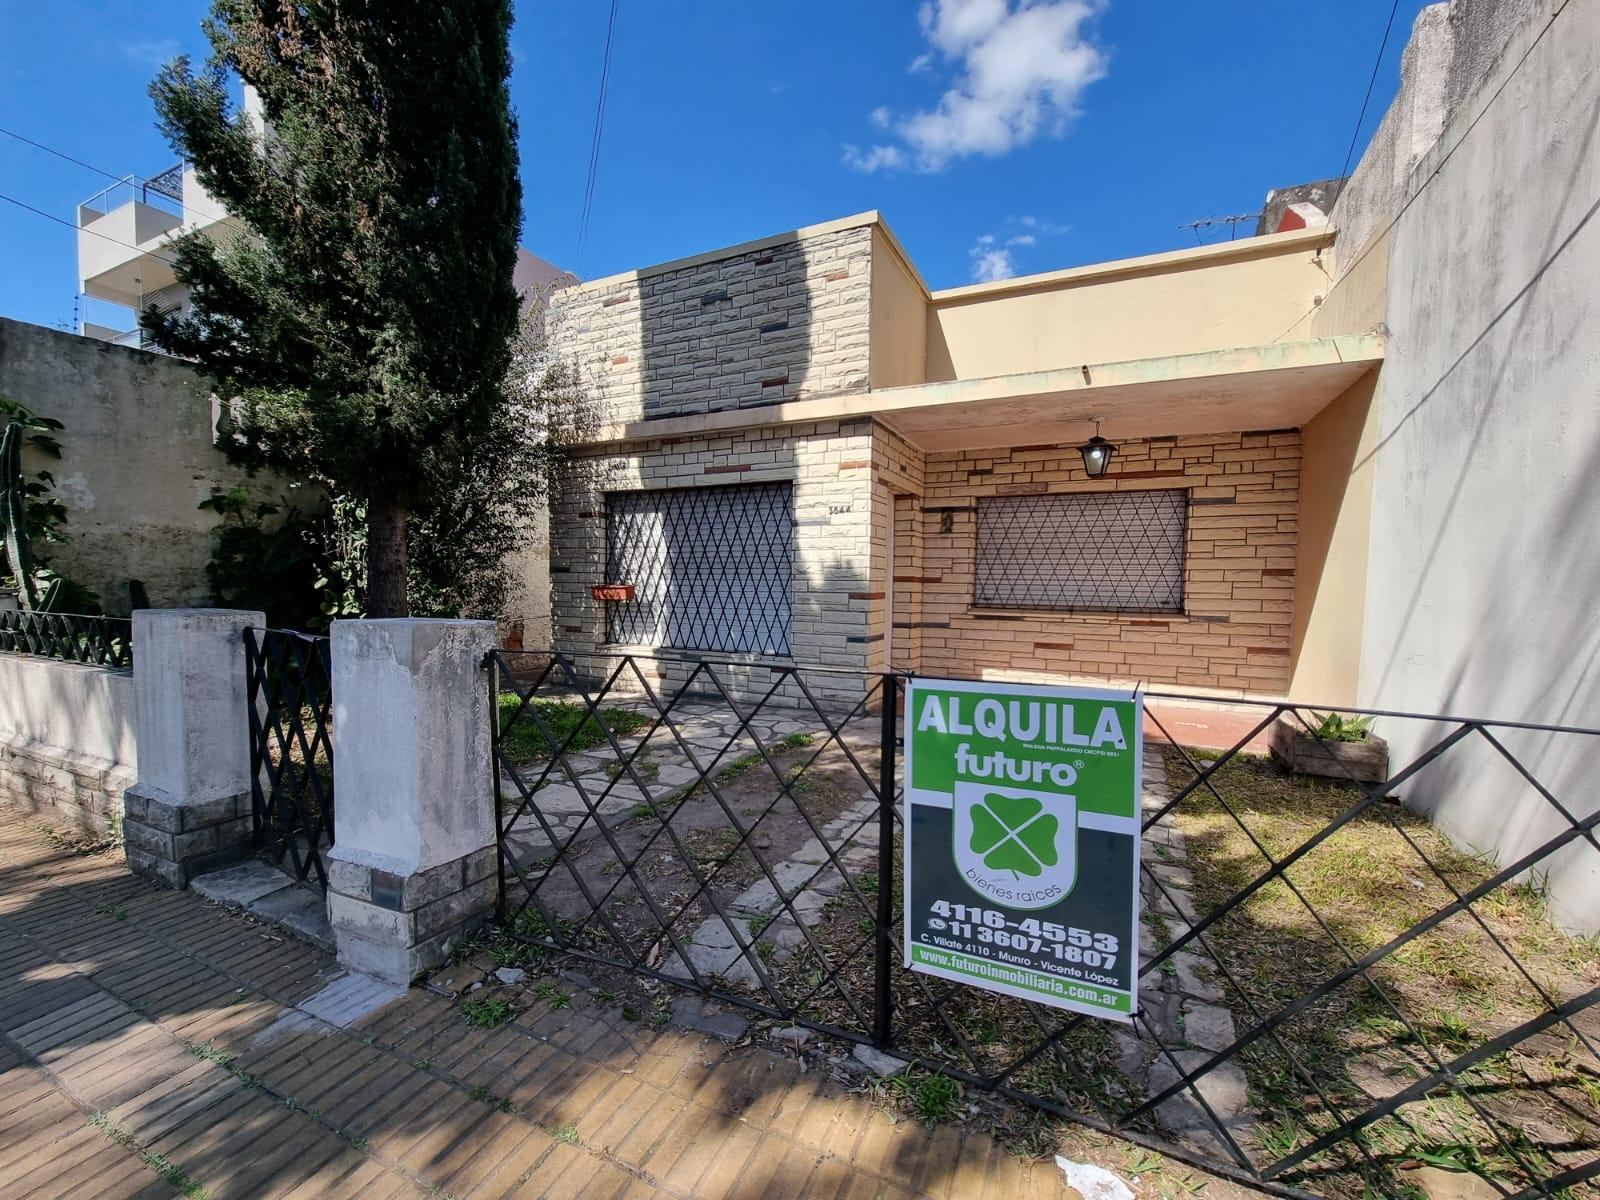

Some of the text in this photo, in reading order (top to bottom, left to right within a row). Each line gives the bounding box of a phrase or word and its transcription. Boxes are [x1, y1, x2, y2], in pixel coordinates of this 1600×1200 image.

[917, 695, 1127, 750] ALQUILA
[955, 743, 1077, 787] futuro
[966, 868, 1013, 900] bienes
[930, 900, 1119, 953] 4116-4553
[949, 921, 1116, 970] 11 3607-1807
[920, 949, 1118, 1006] www.futuroinmobiliaria.com.ar
[921, 933, 931, 943] C.
[933, 936, 963, 950] Villate
[965, 943, 990, 956] 4110
[998, 951, 1031, 966] Munro
[1041, 960, 1082, 977] Vicente
[1085, 970, 1119, 986] López
